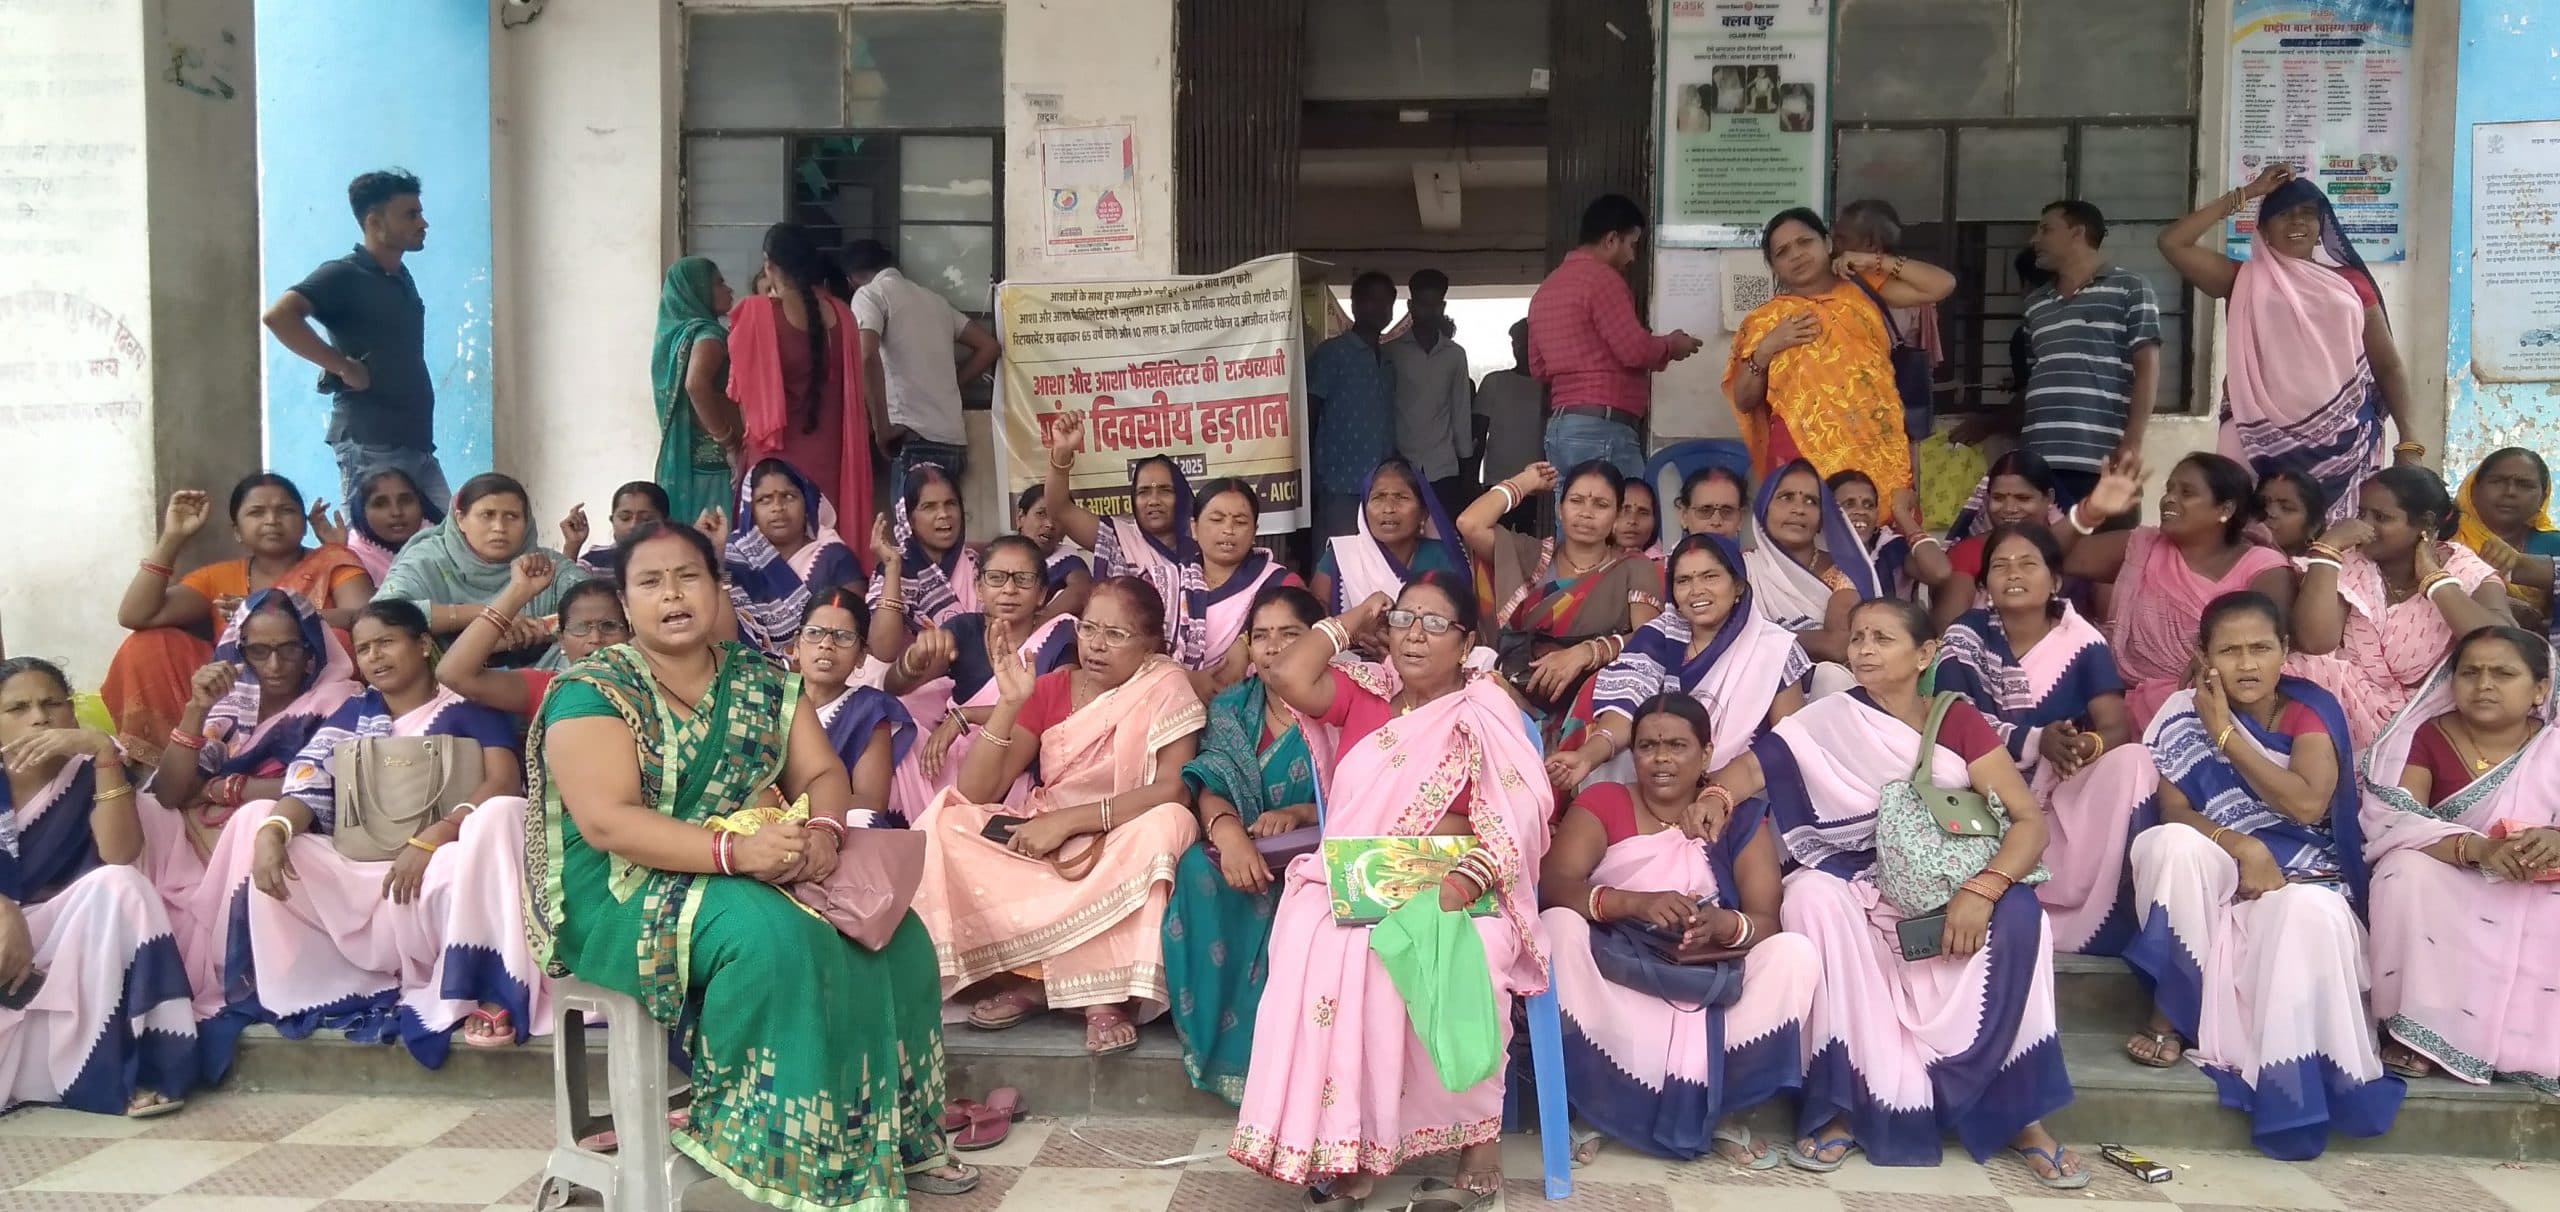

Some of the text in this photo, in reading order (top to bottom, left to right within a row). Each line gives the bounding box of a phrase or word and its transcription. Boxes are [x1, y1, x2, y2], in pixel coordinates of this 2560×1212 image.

[1722, 15, 1775, 31] क्लब फुट
[2293, 22, 2313, 33] बाल
[1204, 278, 1219, 289] साथ
[1220, 274, 1237, 290] लागू
[1236, 270, 1254, 285] करो!
[1019, 312, 1037, 325] आशा
[1039, 309, 1052, 324] और
[1053, 311, 1071, 323] आशा
[1120, 305, 1145, 322] न्यूनतम
[1146, 304, 1154, 316] 21
[1155, 302, 1173, 316] हजार
[1183, 298, 1191, 312] के
[1191, 295, 1216, 311] मासिक
[1217, 292, 1240, 308] मानदेय
[1241, 292, 1252, 305] की
[1252, 288, 1272, 304] गारंटी
[1272, 286, 1288, 301] करो!
[1050, 288, 1077, 302] आशाओं
[1079, 288, 1087, 301] के
[1088, 291, 1102, 302] साथ
[1103, 291, 1114, 305] हुए
[1013, 330, 1044, 346] रिटायरमेंट
[1082, 330, 1091, 342] 65
[1092, 327, 1104, 341] वर्ष
[1104, 326, 1118, 340] करो
[1118, 324, 1132, 339] और
[1133, 326, 1141, 338] 10
[1142, 325, 1159, 337] लाख
[1170, 323, 1180, 335] का
[1181, 316, 1213, 334] रिटायरमेंट
[1214, 314, 1233, 330] पैकेज
[1234, 317, 1240, 329] व
[1241, 311, 1269, 328] आजीवन
[1269, 309, 1286, 323] पेंशन
[1033, 348, 1286, 396] आशा और आशा फैसिलिटेटर की राज्यव्यापी
[1089, 390, 1194, 453] दिवसीय
[1196, 392, 1290, 454] हड़ताल
[1179, 457, 1204, 475] 2025
[1270, 479, 1298, 503] AICC
[1087, 496, 1121, 516] आशा
